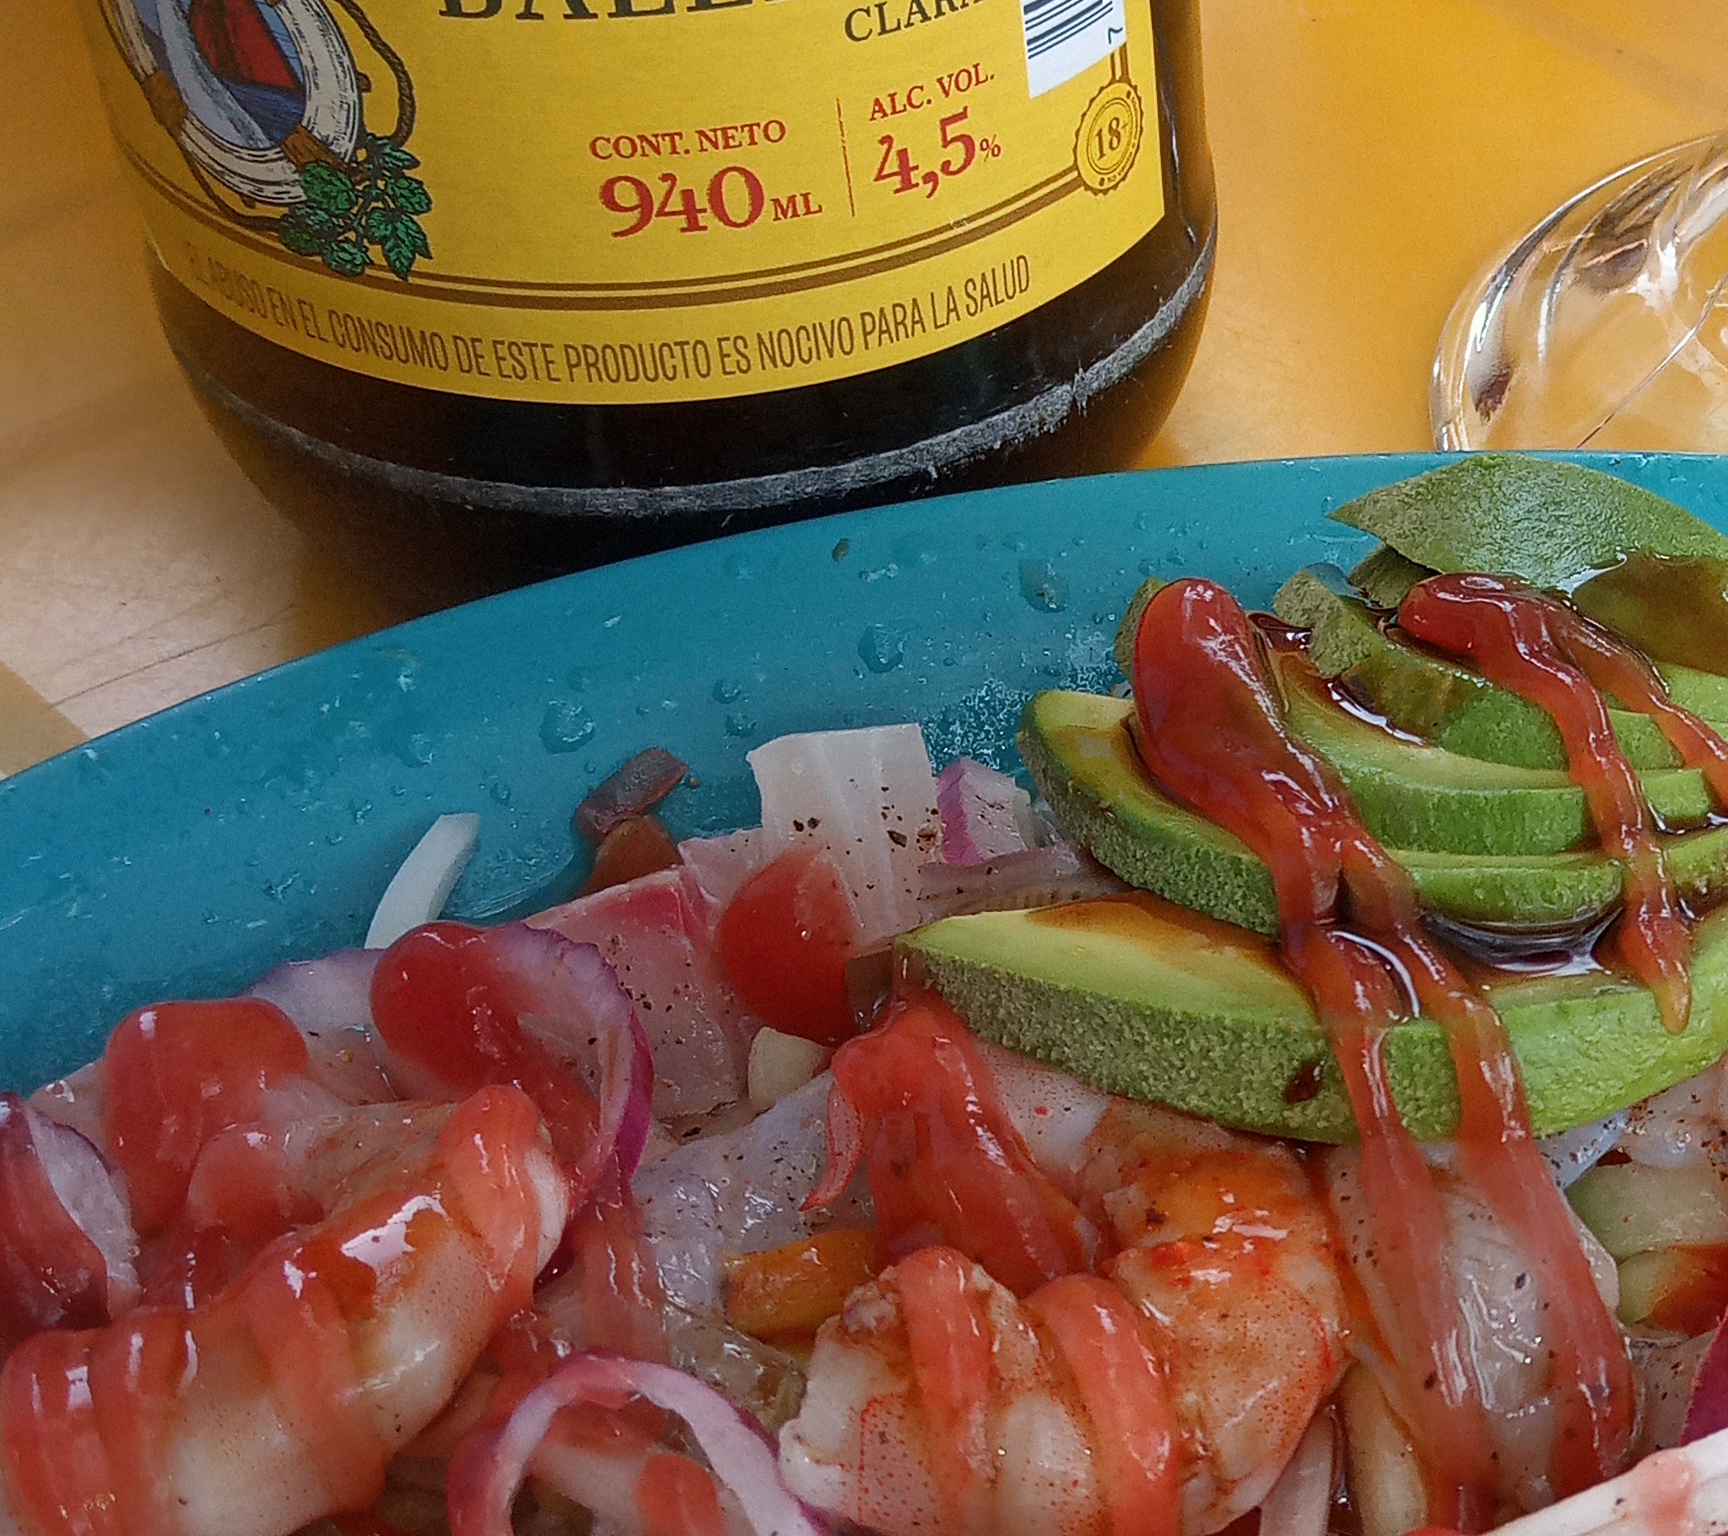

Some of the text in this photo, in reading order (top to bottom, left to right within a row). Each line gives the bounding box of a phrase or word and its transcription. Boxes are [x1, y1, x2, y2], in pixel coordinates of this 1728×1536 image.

[869, 62, 996, 122] ALC. VOL.
[589, 119, 787, 161] CONT. NETO
[266, 287, 299, 331] EN
[297, 298, 330, 343] EL
[328, 309, 449, 372] CONSUMO
[455, 336, 491, 376] DE
[492, 340, 562, 383] ESTE
[564, 338, 712, 384] PRODUCTO
[718, 336, 751, 376] ES
[757, 316, 855, 370] NOCIVO
[860, 297, 927, 350] PARA
[930, 286, 961, 330] LA
[964, 254, 1031, 318] SALUD
